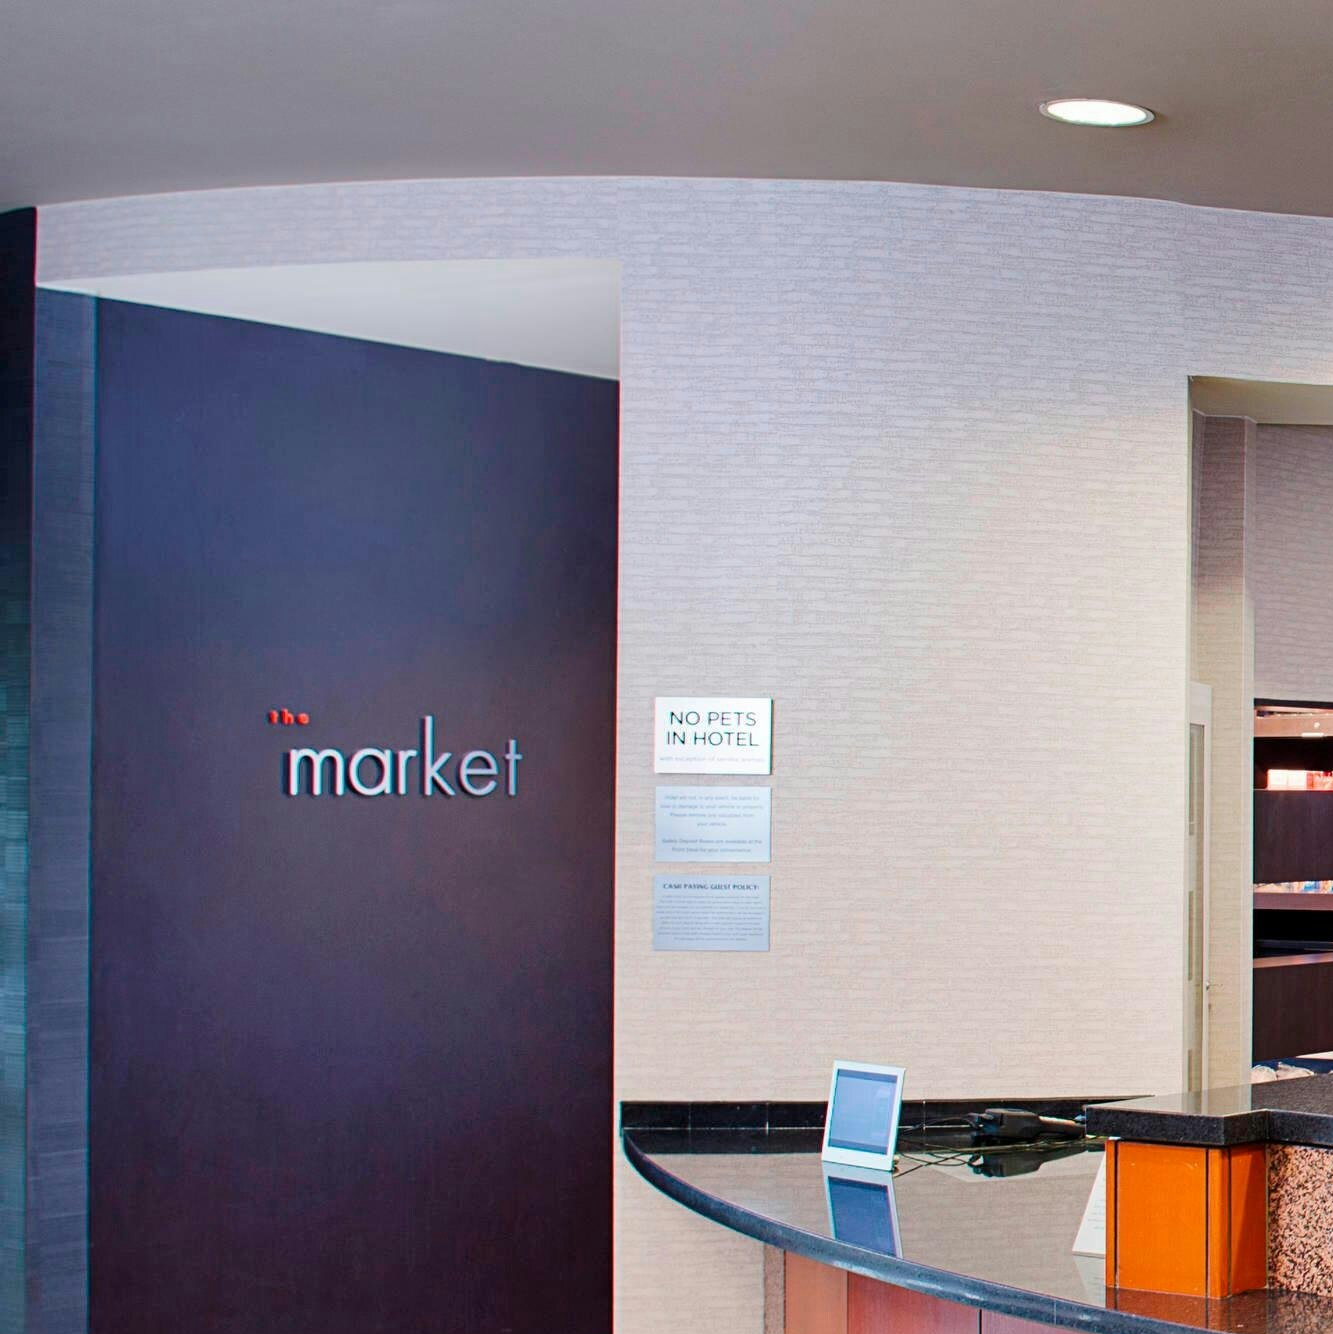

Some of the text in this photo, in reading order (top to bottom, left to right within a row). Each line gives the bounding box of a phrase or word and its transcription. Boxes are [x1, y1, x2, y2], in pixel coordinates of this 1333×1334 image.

[268, 708, 309, 725] the
[669, 711, 757, 727] NO PETS
[666, 731, 760, 747] IN HOTEL
[288, 715, 523, 796] market
